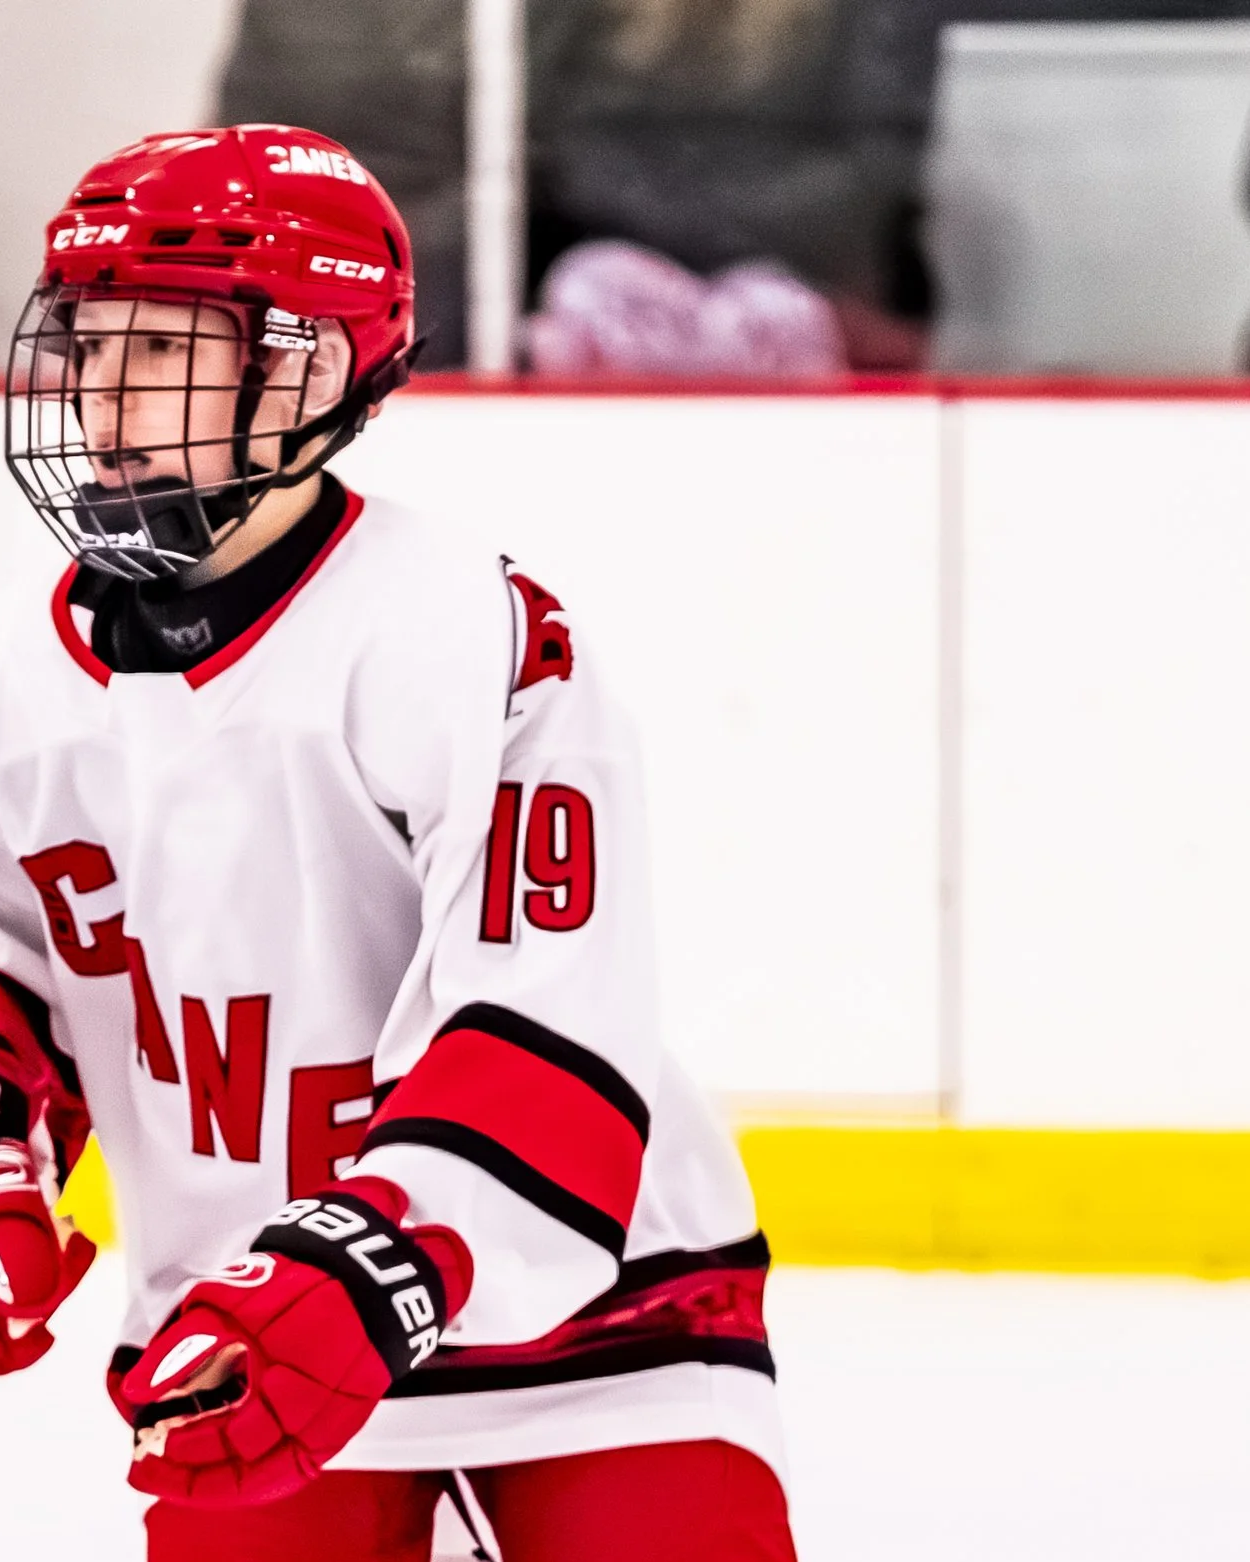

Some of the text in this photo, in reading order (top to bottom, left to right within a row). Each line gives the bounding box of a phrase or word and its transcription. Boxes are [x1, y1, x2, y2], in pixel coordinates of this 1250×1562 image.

[52, 224, 130, 251] CCM
[309, 255, 386, 283] CCM
[479, 780, 596, 944] 19
